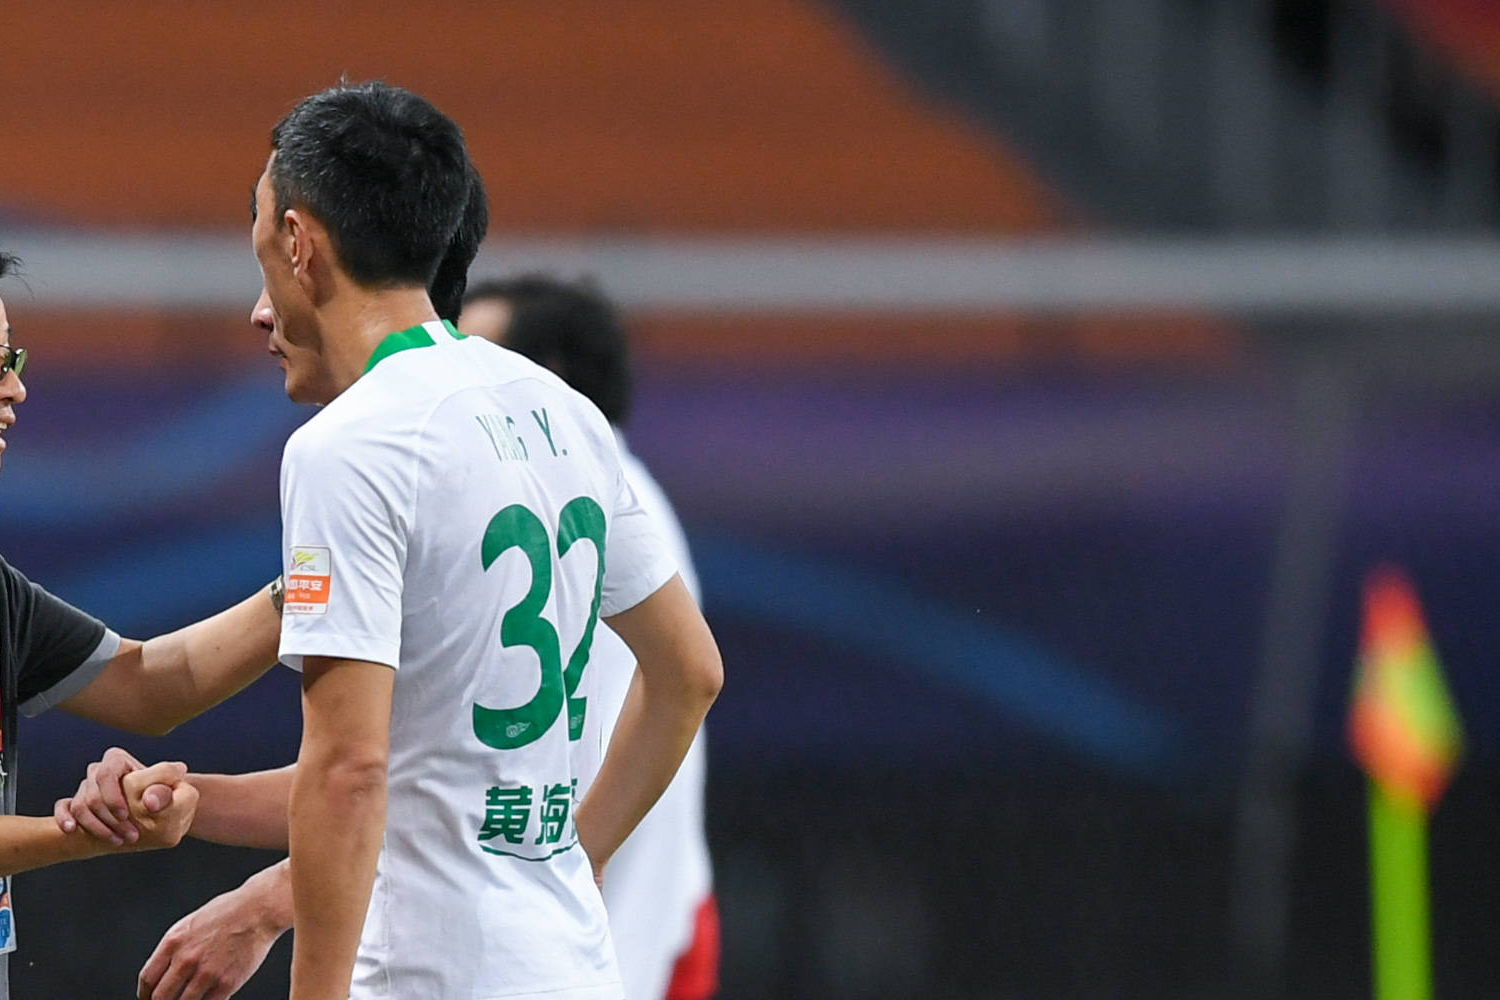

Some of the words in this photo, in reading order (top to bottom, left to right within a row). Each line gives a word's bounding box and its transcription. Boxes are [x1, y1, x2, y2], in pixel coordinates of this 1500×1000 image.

[531, 407, 567, 457] Y.
[287, 579, 323, 591] 国平安
[473, 496, 606, 750] 32
[477, 778, 579, 845] 黄海
